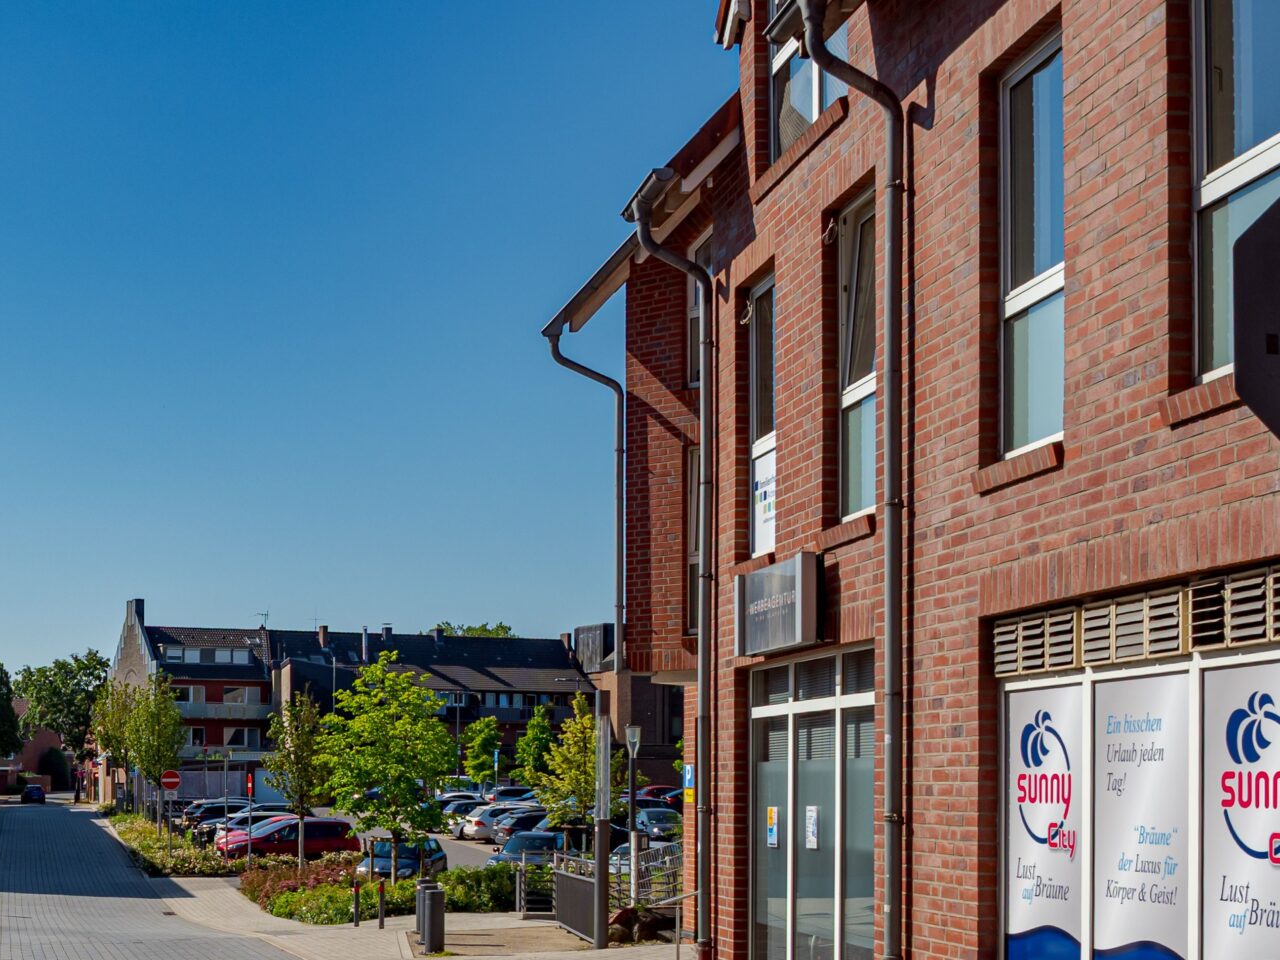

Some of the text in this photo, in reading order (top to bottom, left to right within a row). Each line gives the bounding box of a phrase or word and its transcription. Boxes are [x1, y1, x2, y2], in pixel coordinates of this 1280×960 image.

[1106, 712, 1162, 735] Ein bisschen
[1106, 742, 1165, 768] Urlaub jeden
[1106, 773, 1127, 797] Tag!
[1048, 822, 1076, 858] City
[1016, 857, 1036, 880] Lust
[1118, 852, 1179, 880] der Luxus für
[1022, 875, 1070, 904] auf Bräune
[1106, 879, 1178, 906] Körper & Geist!
[1220, 875, 1250, 904] Lust
[1228, 907, 1249, 935] auf
